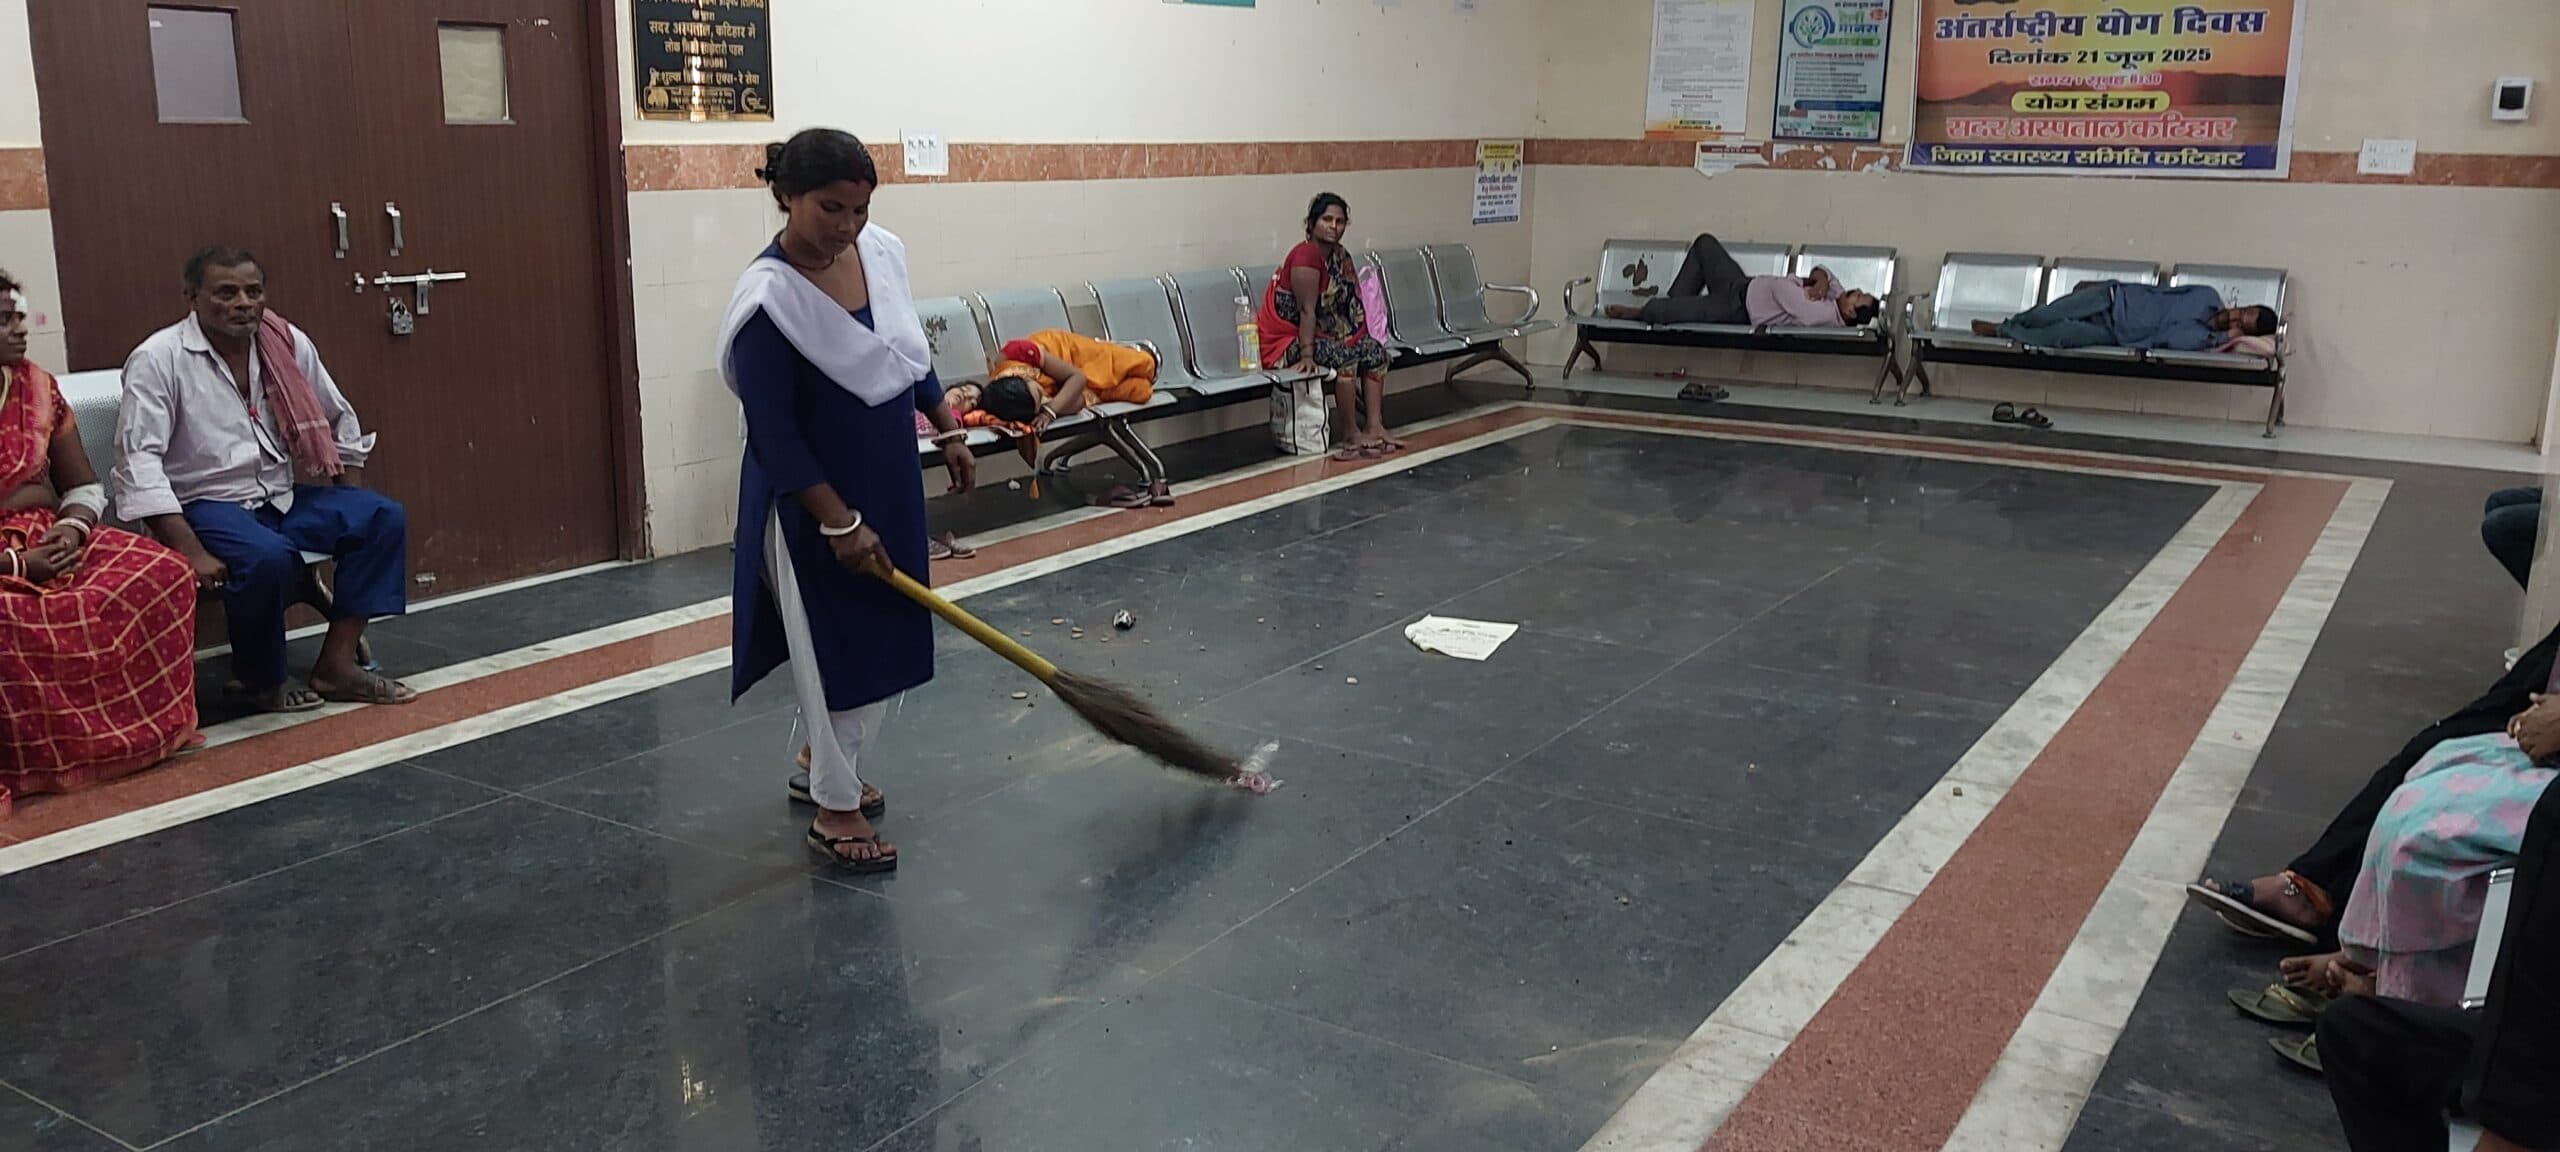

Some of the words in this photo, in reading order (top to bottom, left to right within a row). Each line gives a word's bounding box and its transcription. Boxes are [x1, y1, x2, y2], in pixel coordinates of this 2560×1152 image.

[648, 21, 670, 34] सदर
[715, 21, 745, 39] कटिहार
[1936, 10, 2088, 43] अंतर्राष्ट्रीय
[2097, 8, 2164, 36] योग
[2173, 6, 2269, 34] दिवस
[1988, 48, 2072, 65] दिनांक
[2076, 49, 2099, 64] 21
[2103, 50, 2157, 69] जून
[2161, 48, 2211, 63] 2025
[2024, 94, 2080, 109] योग
[2084, 93, 2158, 110] संगम
[1946, 116, 2009, 138] सदर
[2010, 117, 2127, 139] अस्पताल
[2128, 111, 2237, 140] कटिहार
[1931, 145, 1987, 164] जिला
[1988, 149, 2072, 164] स्वास्थ्य
[2074, 146, 2151, 166] समिति
[2153, 147, 2246, 167] कटिहार
